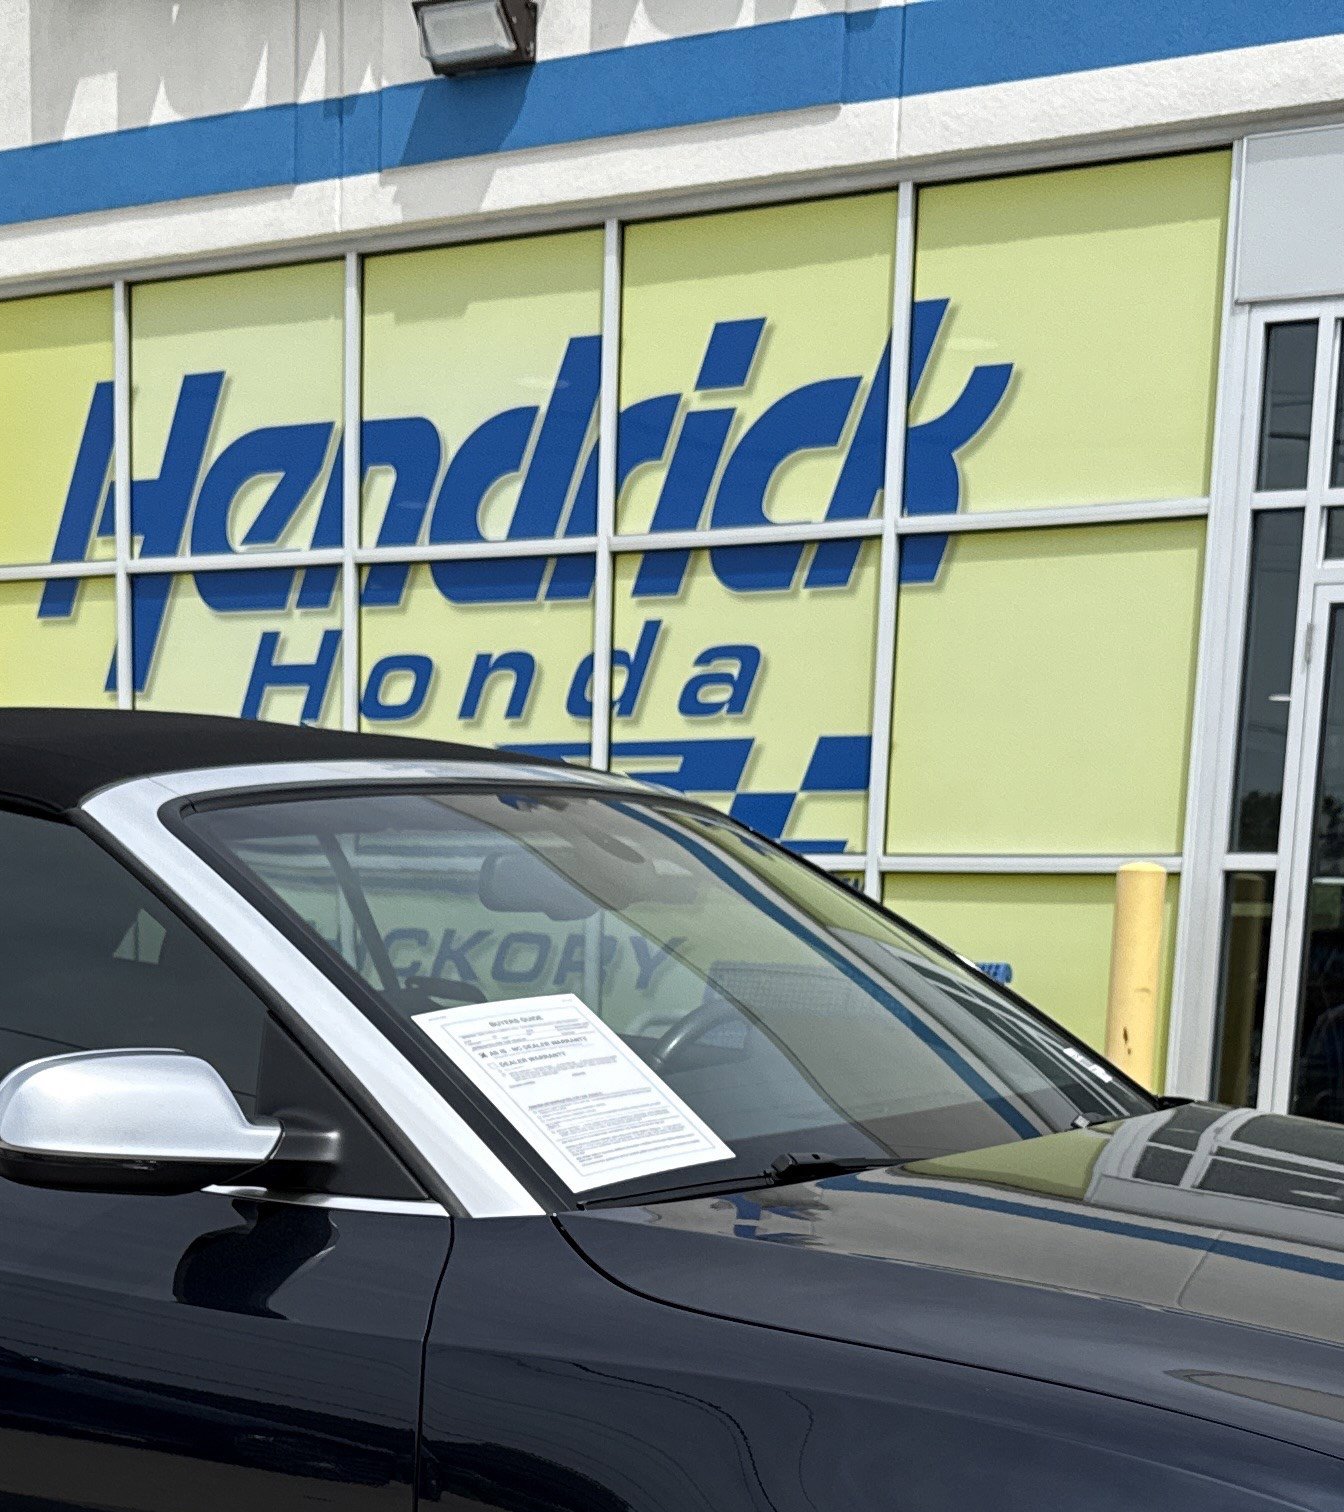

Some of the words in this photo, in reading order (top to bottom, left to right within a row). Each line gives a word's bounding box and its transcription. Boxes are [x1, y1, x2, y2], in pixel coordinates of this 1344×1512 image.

[37, 298, 1014, 693] Hendrick
[240, 618, 762, 722] Honda
[499, 1057, 528, 1068] DEALER
[528, 1051, 567, 1062] WARRANTY
[522, 1040, 551, 1050] DEALER
[551, 1036, 588, 1046] WARRANTY
